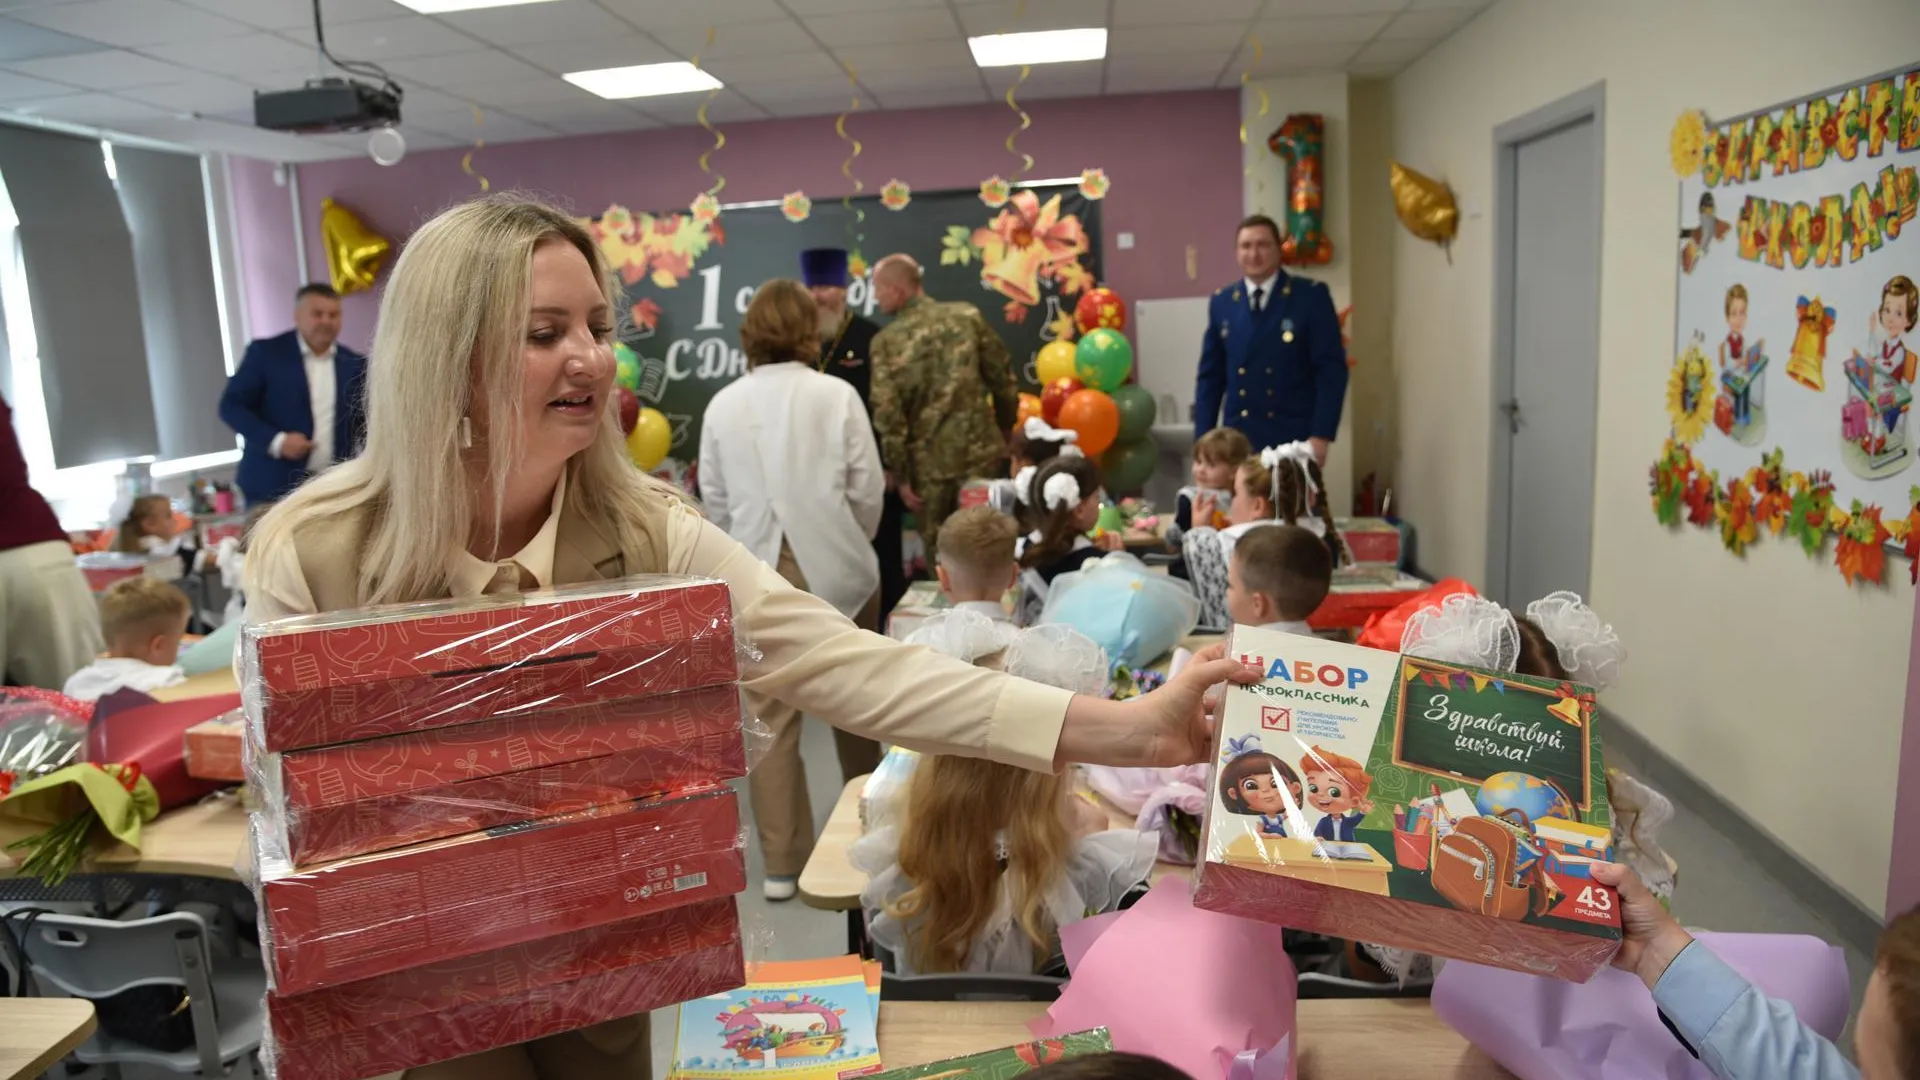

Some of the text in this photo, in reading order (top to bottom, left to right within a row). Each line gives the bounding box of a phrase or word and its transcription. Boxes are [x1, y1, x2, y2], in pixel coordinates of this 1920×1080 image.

[694, 264, 723, 331] 1
[696, 337, 748, 380] Дн
[1240, 654, 1369, 690] НАБОР
[1240, 683, 1370, 709] ПЕРВОКЛАССНИКА
[1423, 694, 1566, 752] Здравствуй,
[1454, 734, 1534, 763] школа!
[1574, 907, 1612, 920] ПРЕДМЕТА
[1576, 885, 1612, 911] 43
